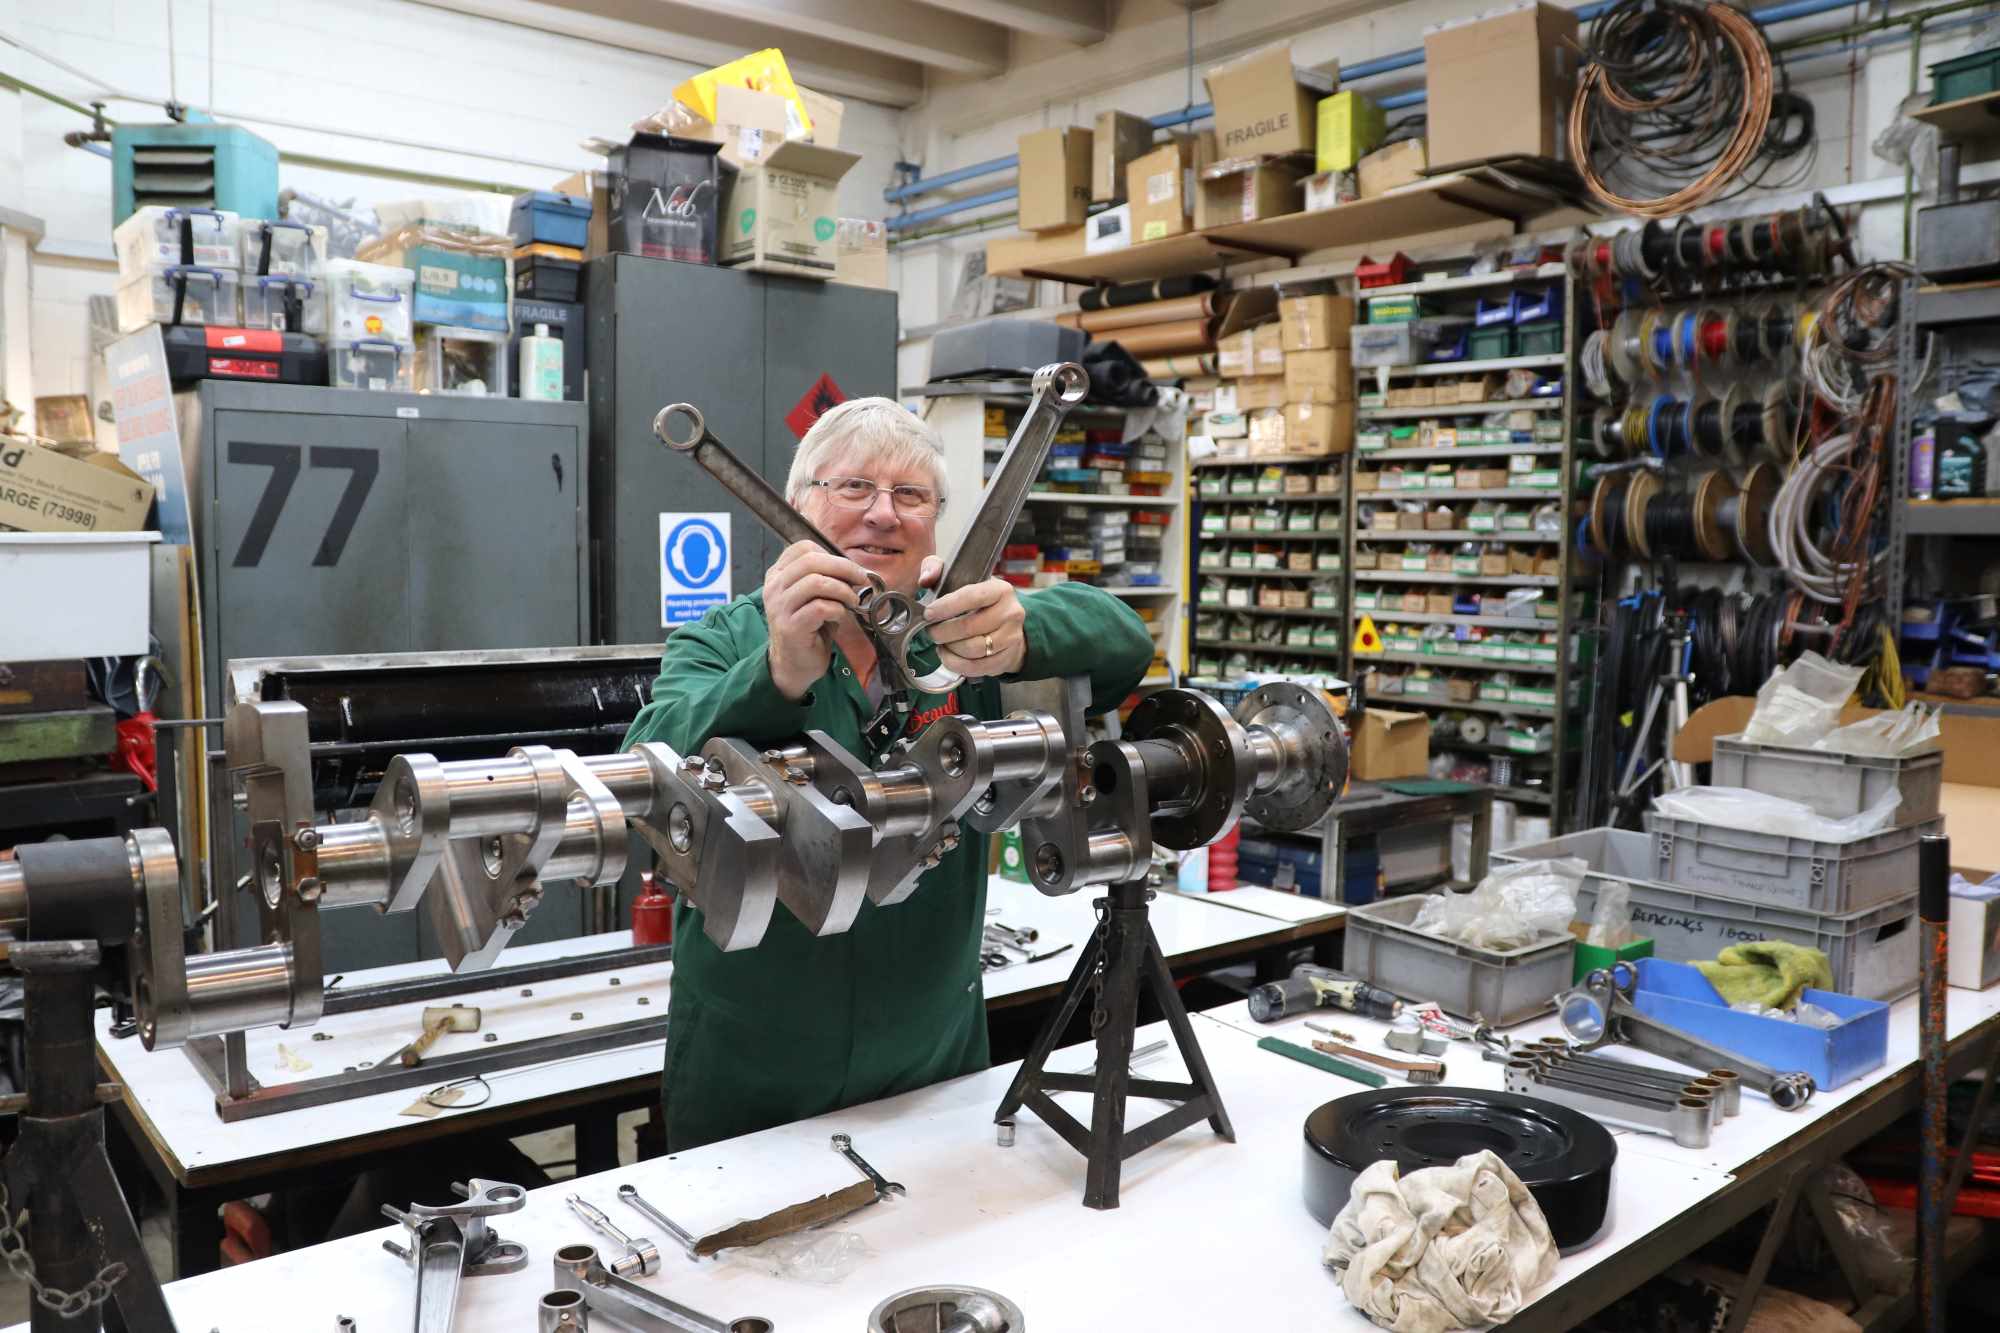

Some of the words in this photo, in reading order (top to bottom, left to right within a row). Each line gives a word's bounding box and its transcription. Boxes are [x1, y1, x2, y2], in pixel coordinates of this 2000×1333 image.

[1225, 113, 1289, 147] FRAGILE
[642, 180, 710, 218] Ned
[514, 305, 568, 321] FRAGILE
[43, 500, 97, 530] (73998)
[227, 441, 379, 567] 77
[1631, 908, 1704, 933] BEARINGS
